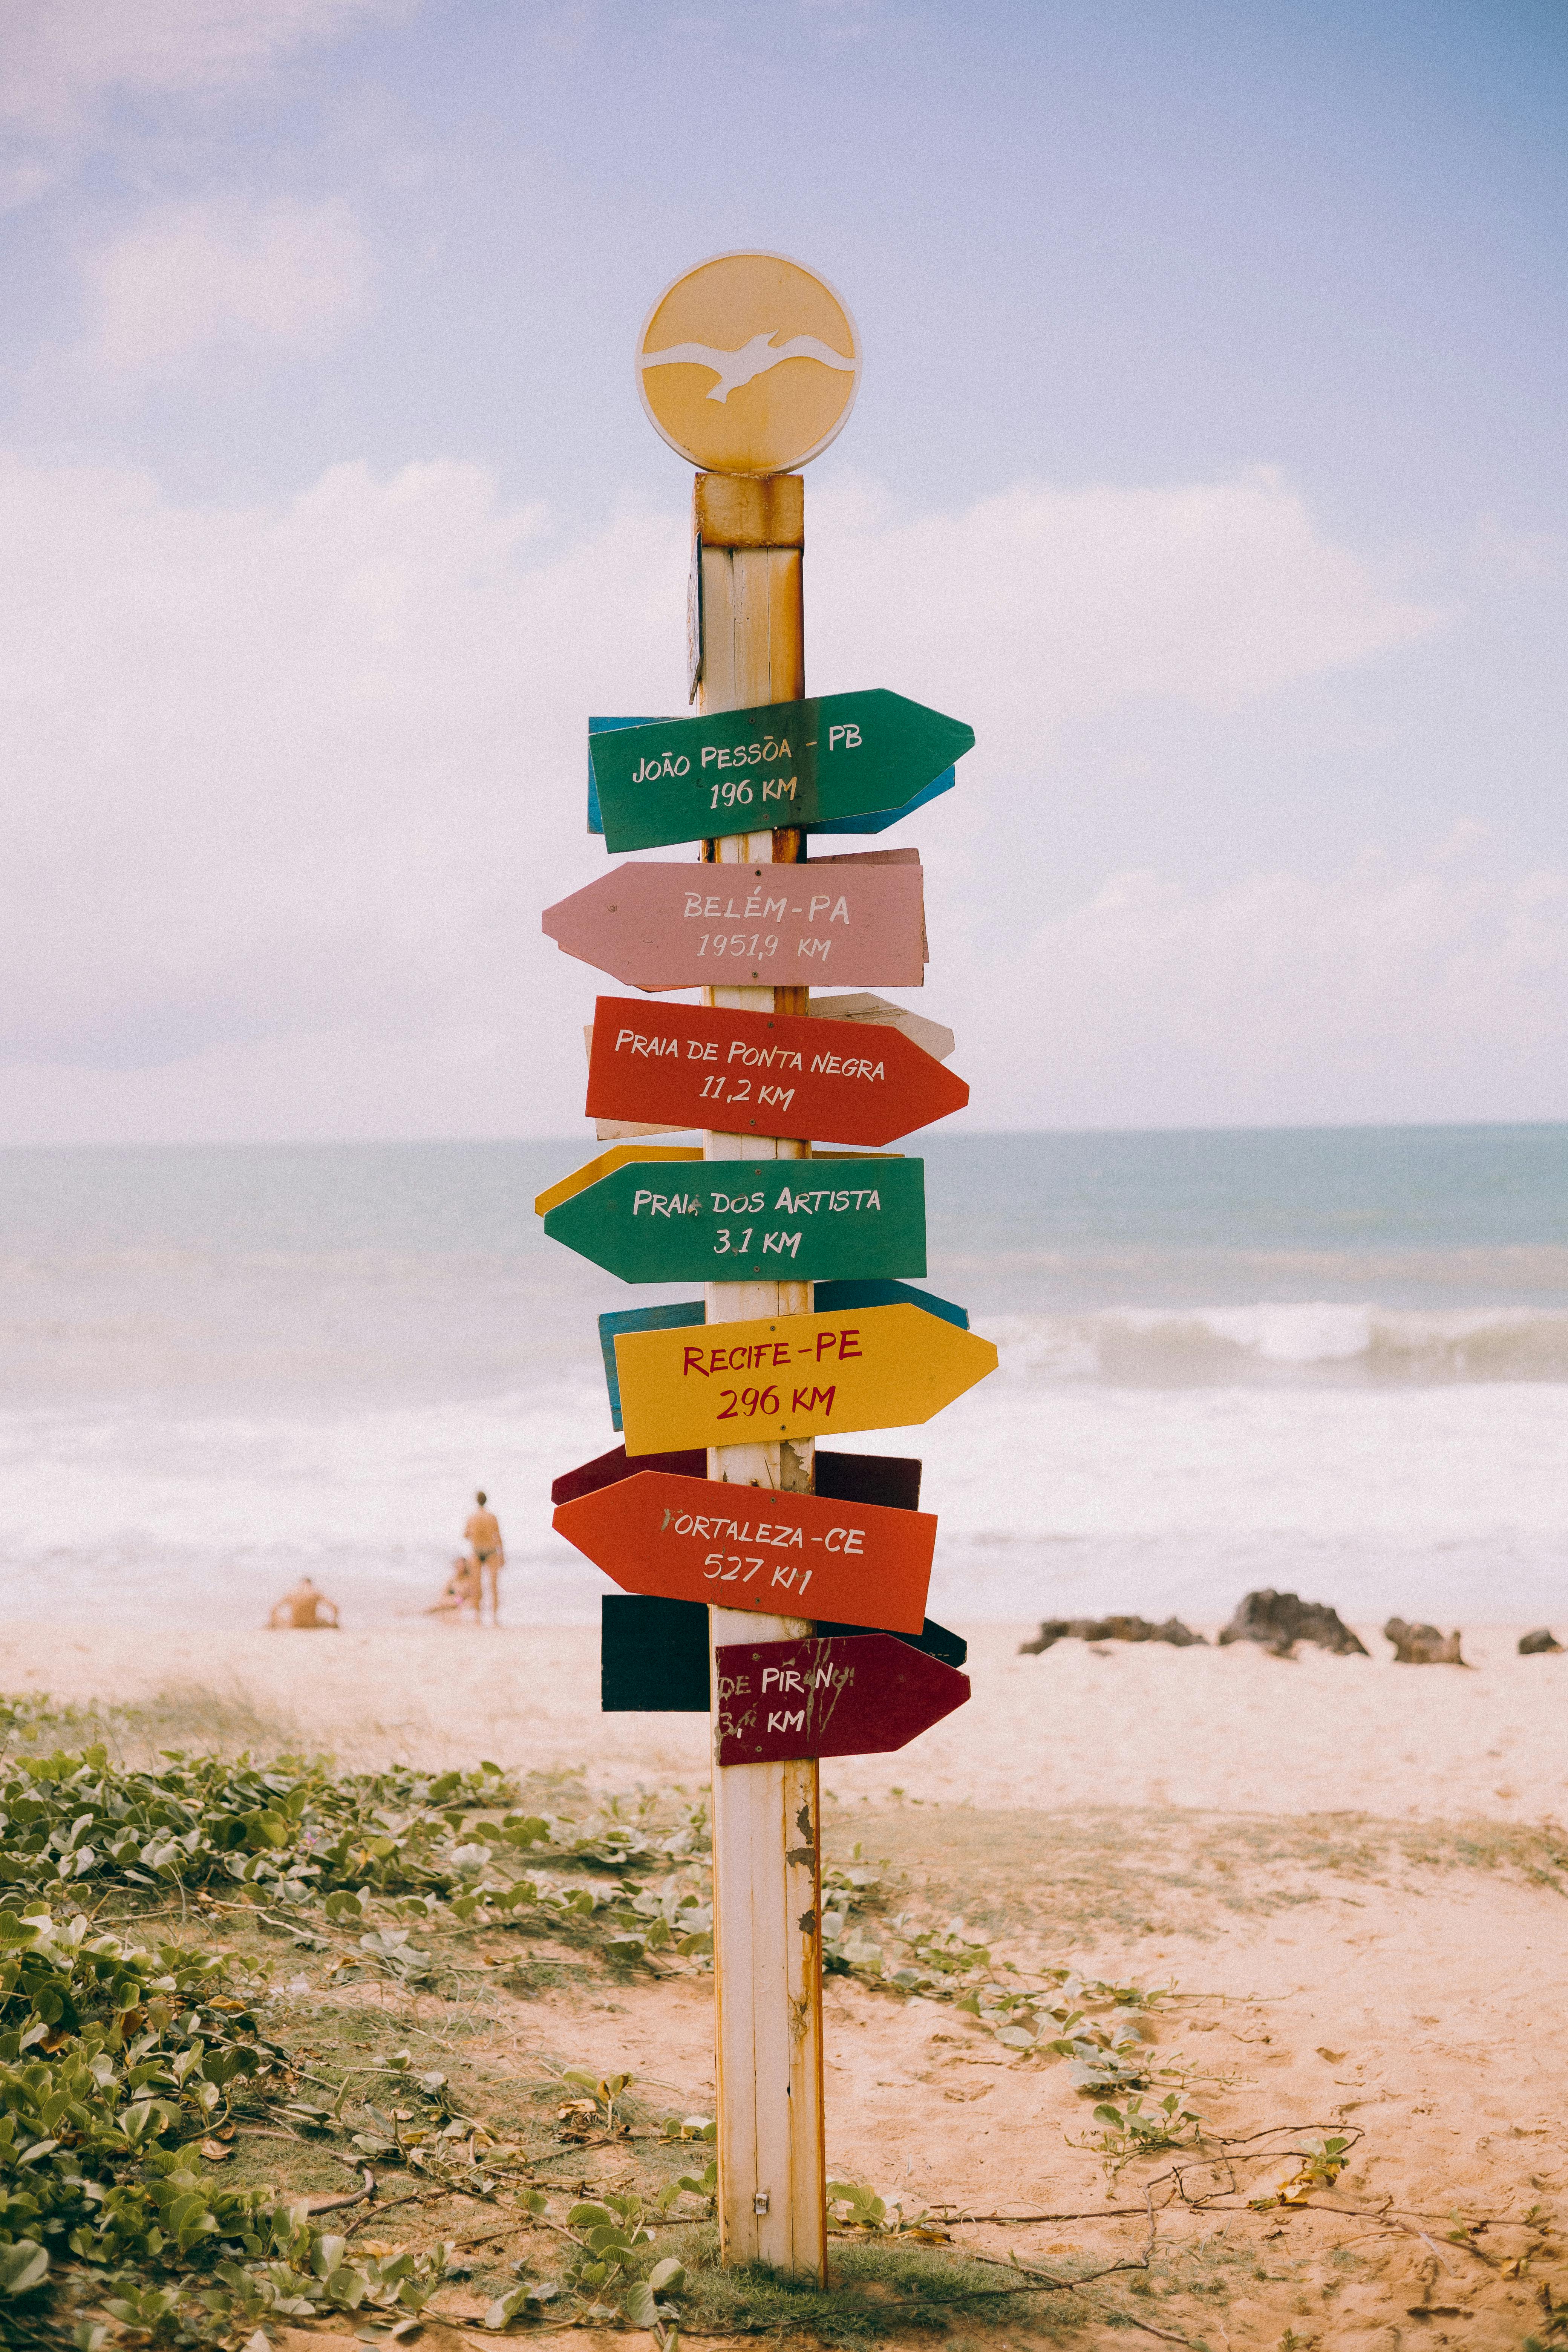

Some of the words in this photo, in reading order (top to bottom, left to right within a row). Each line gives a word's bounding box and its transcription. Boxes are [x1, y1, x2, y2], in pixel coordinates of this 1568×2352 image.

[830, 724, 862, 750] PB
[710, 780, 753, 809] 196
[763, 777, 796, 801] KM
[697, 934, 778, 960] 1951,9
[798, 939, 831, 961] KM
[615, 1029, 678, 1057] PRAIA
[688, 1041, 718, 1060] DE
[727, 1041, 802, 1070] PONTA
[811, 1052, 884, 1081] NEGRA
[700, 1076, 751, 1103] 11,2
[758, 1086, 795, 1111] KM
[711, 1192, 764, 1213] DOS
[775, 1187, 880, 1214] ARTISTA
[763, 1232, 802, 1258] KM
[717, 1386, 779, 1419] 296
[792, 1386, 836, 1416] KM
[704, 1554, 764, 1582] 527
[771, 1566, 812, 1595] KM
[768, 1710, 805, 1732] KM
